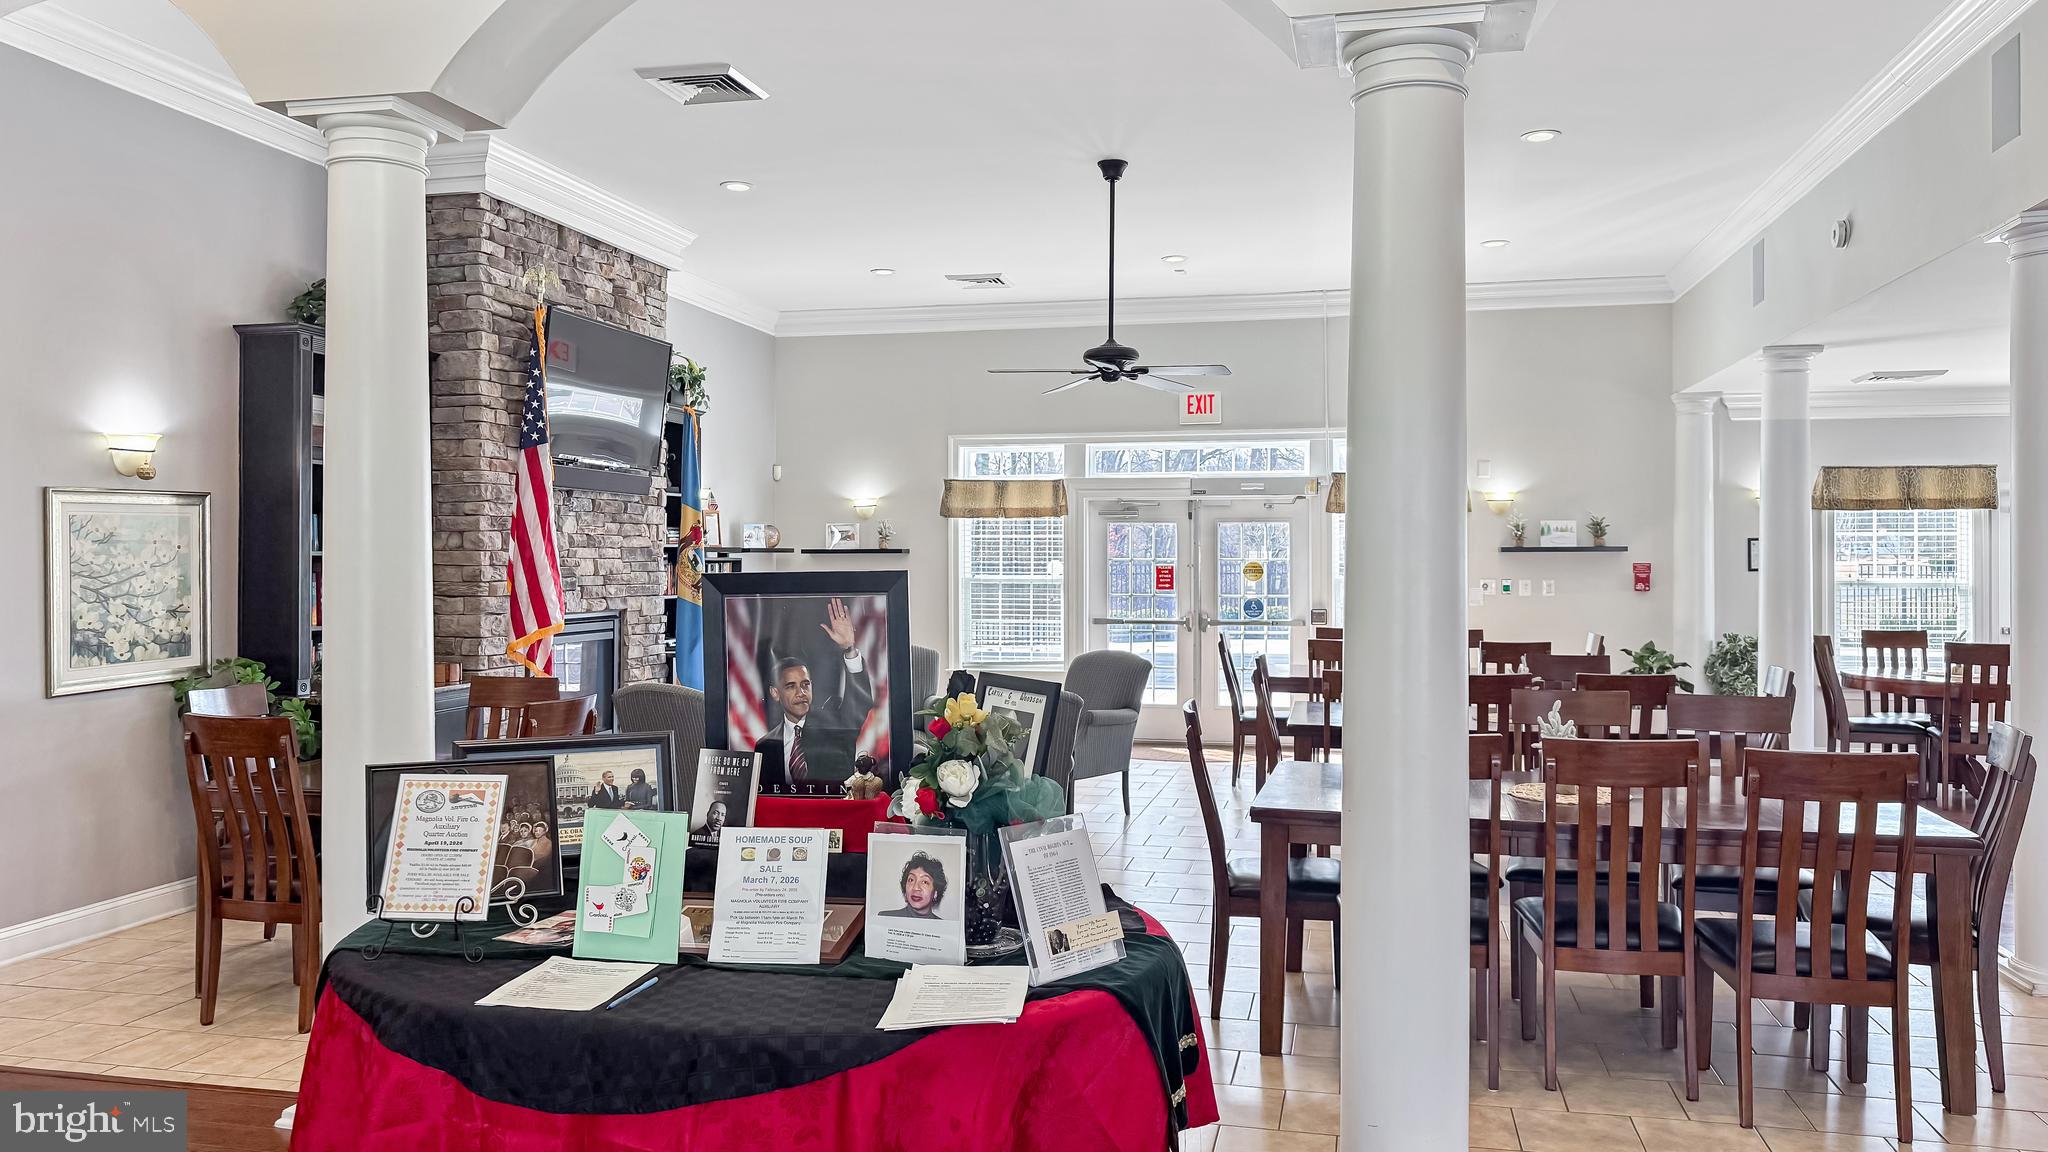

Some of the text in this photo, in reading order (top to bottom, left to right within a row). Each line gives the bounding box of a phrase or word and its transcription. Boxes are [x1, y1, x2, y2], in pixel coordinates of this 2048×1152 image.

[1187, 394, 1215, 415] EXIT
[757, 784, 848, 794] DESTIN
[770, 876, 778, 885] 7,
